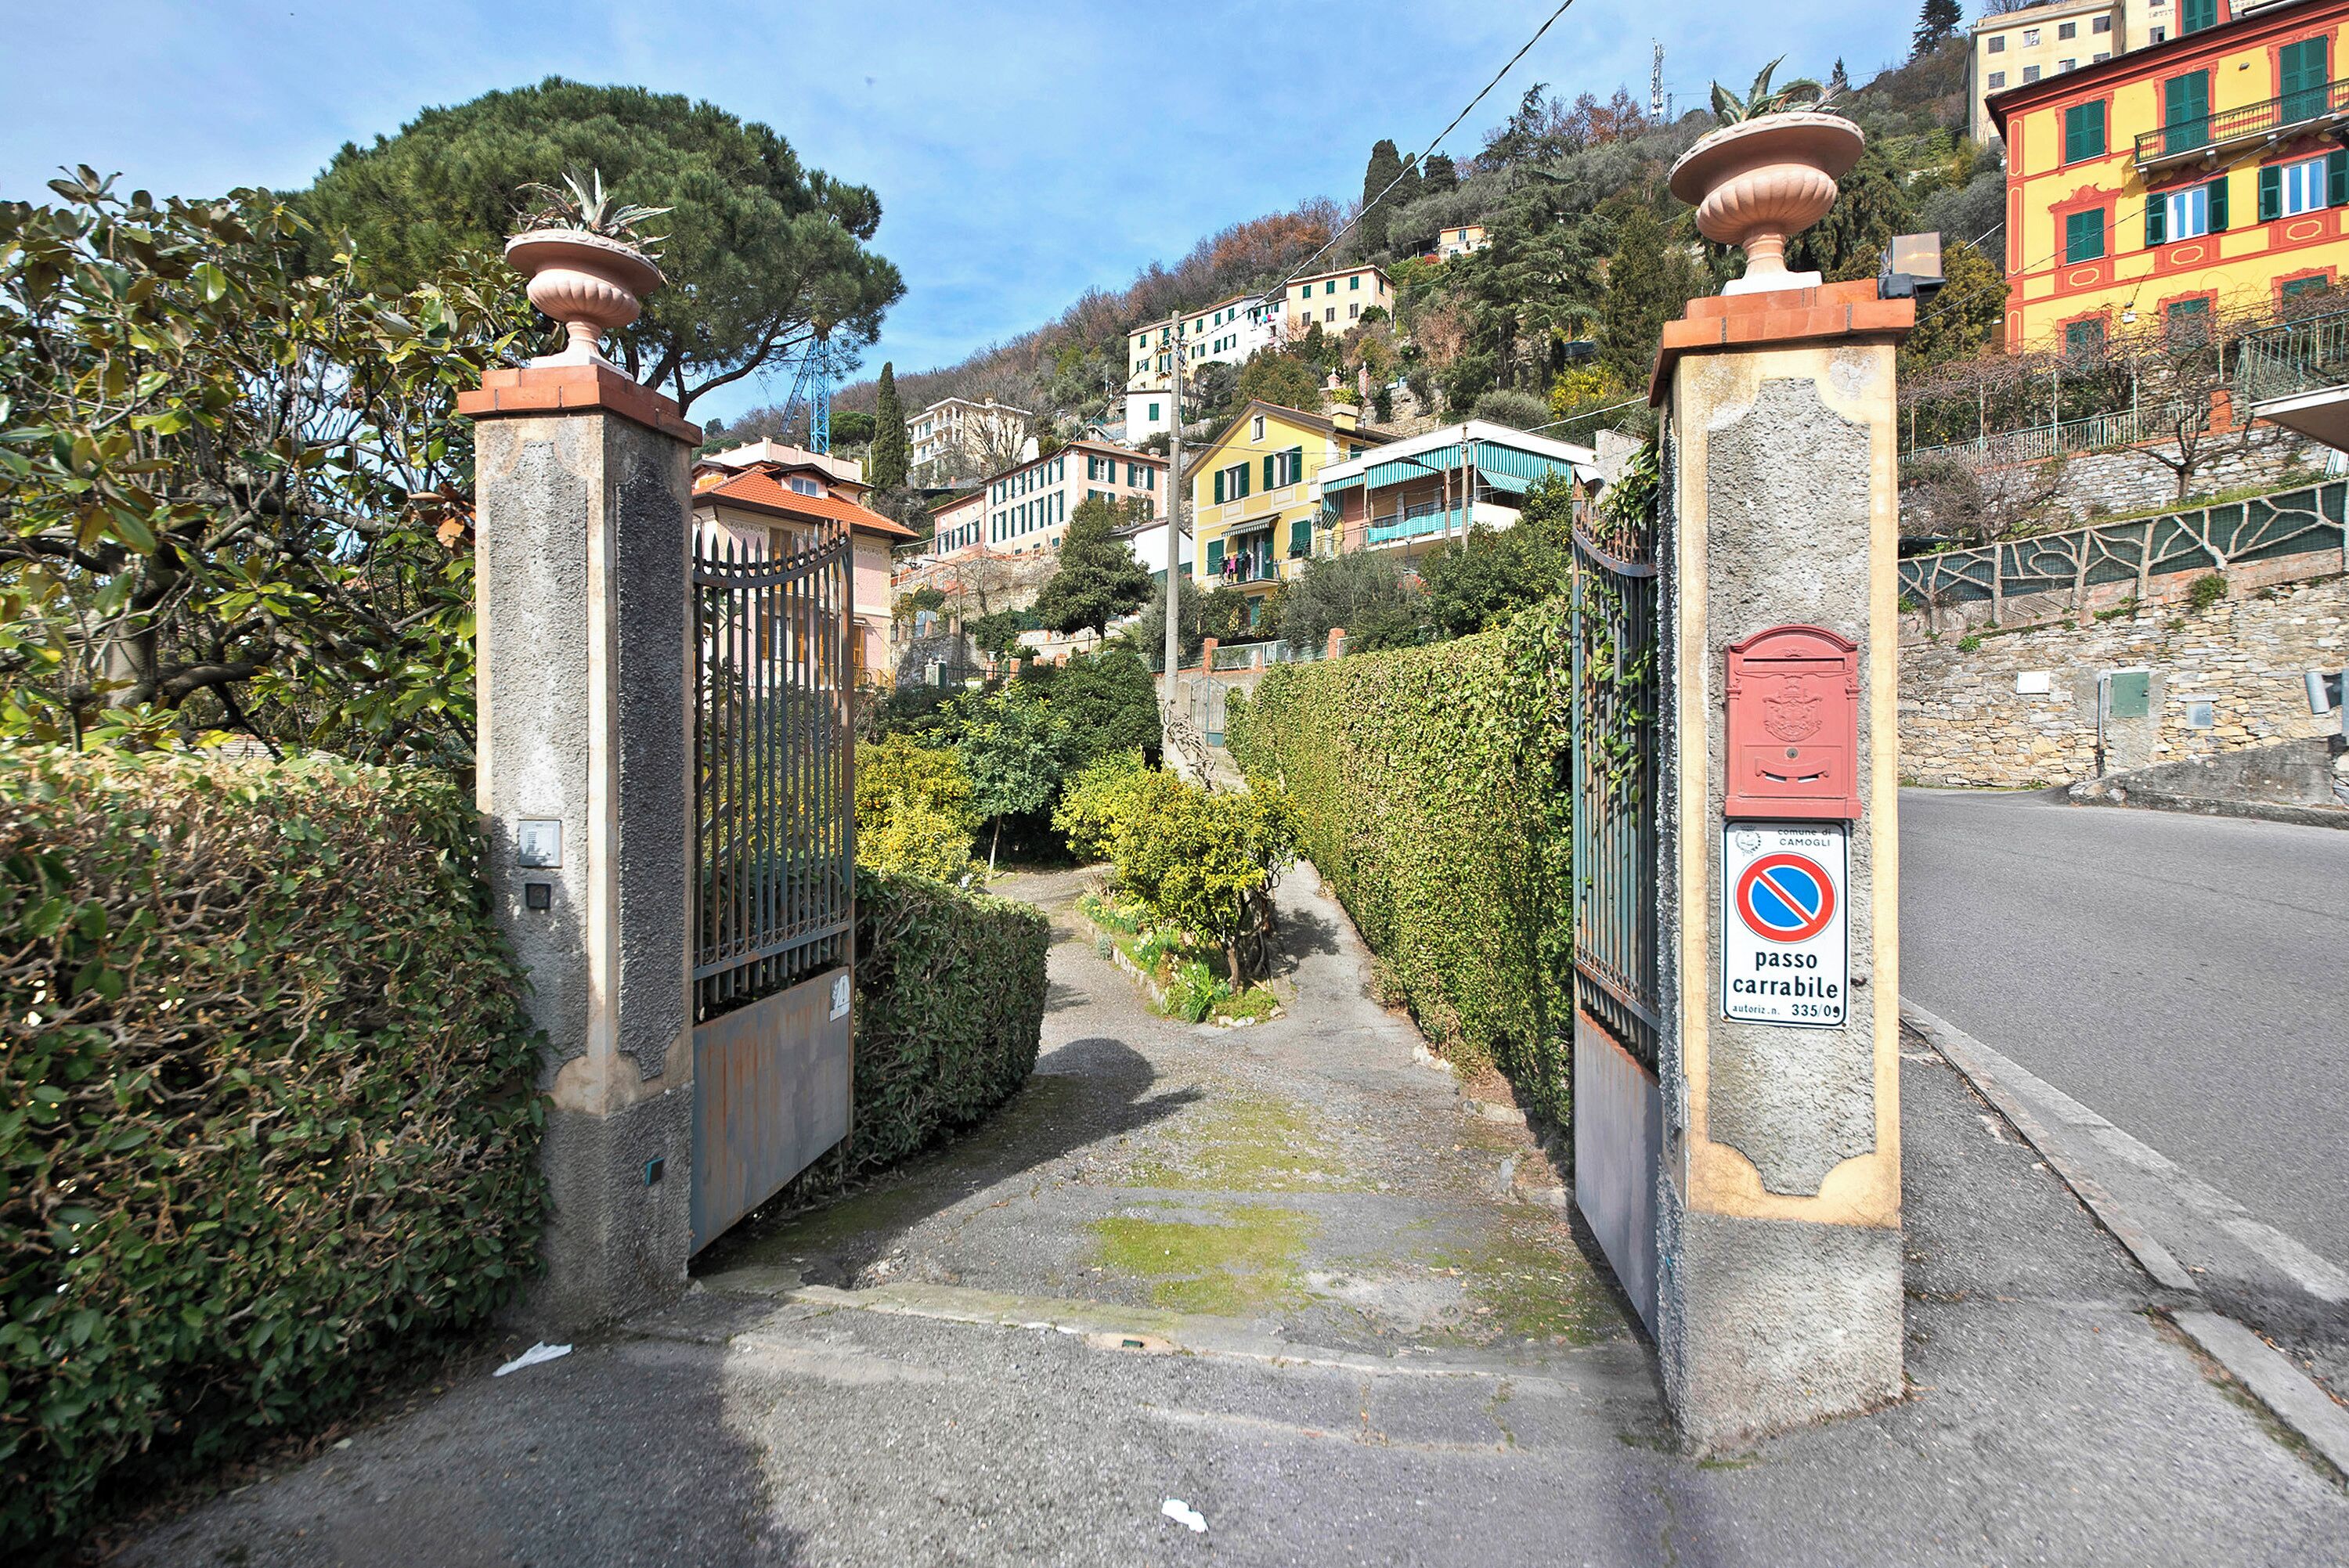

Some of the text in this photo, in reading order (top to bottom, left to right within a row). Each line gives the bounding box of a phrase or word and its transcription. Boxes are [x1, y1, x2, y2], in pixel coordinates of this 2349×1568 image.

[1822, 827, 1831, 836] di
[1780, 838, 1831, 847] CAMOGLI
[1755, 951, 1817, 971] passo
[1733, 976, 1838, 998] carrabile
